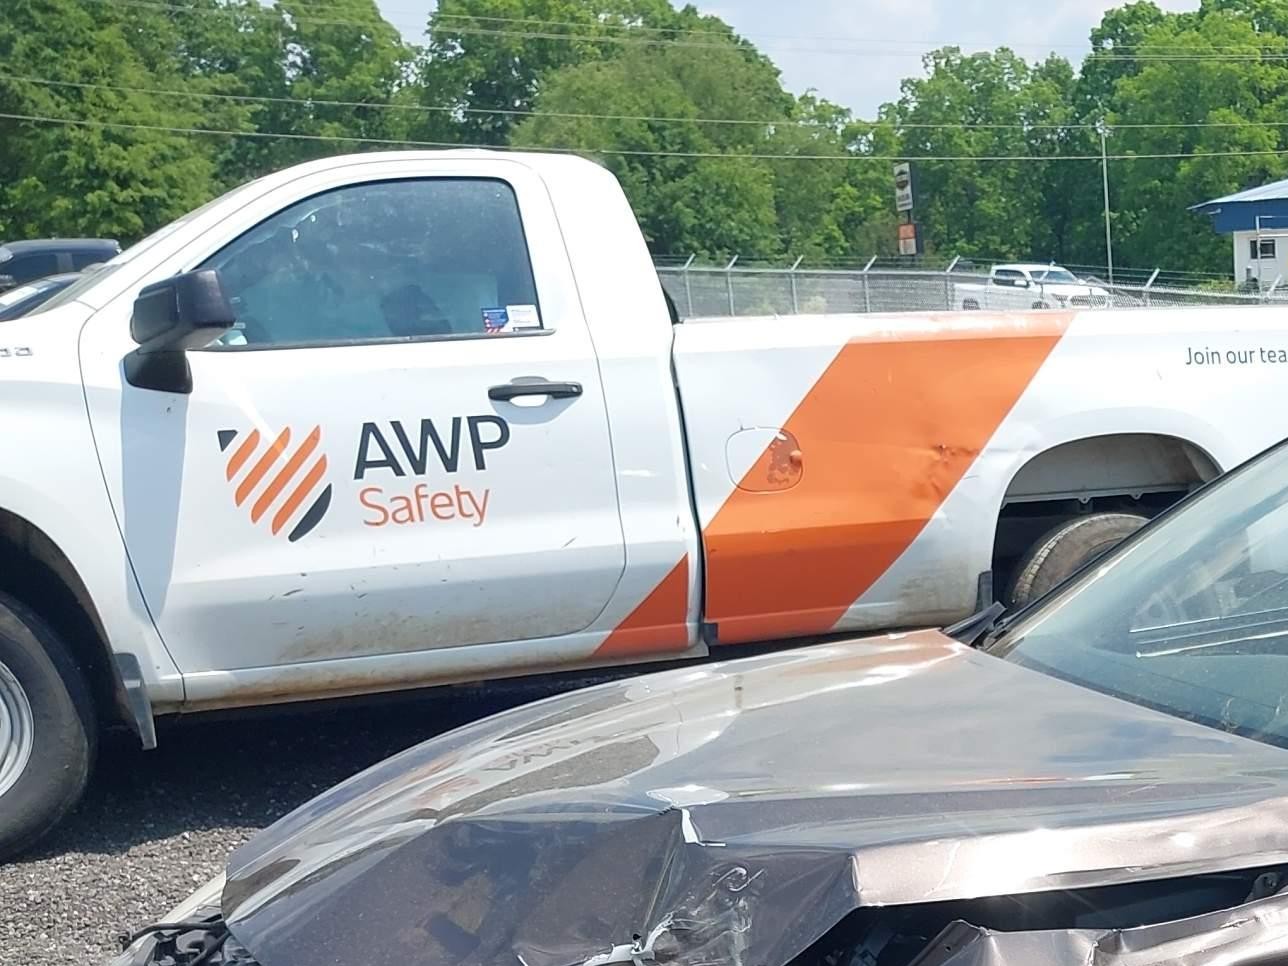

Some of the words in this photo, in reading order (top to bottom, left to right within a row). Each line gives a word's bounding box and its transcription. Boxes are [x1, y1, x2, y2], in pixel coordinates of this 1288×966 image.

[1185, 347, 1221, 365] Join
[1226, 350, 1255, 364] our
[354, 415, 510, 480] AWP
[359, 484, 490, 527] Safety
